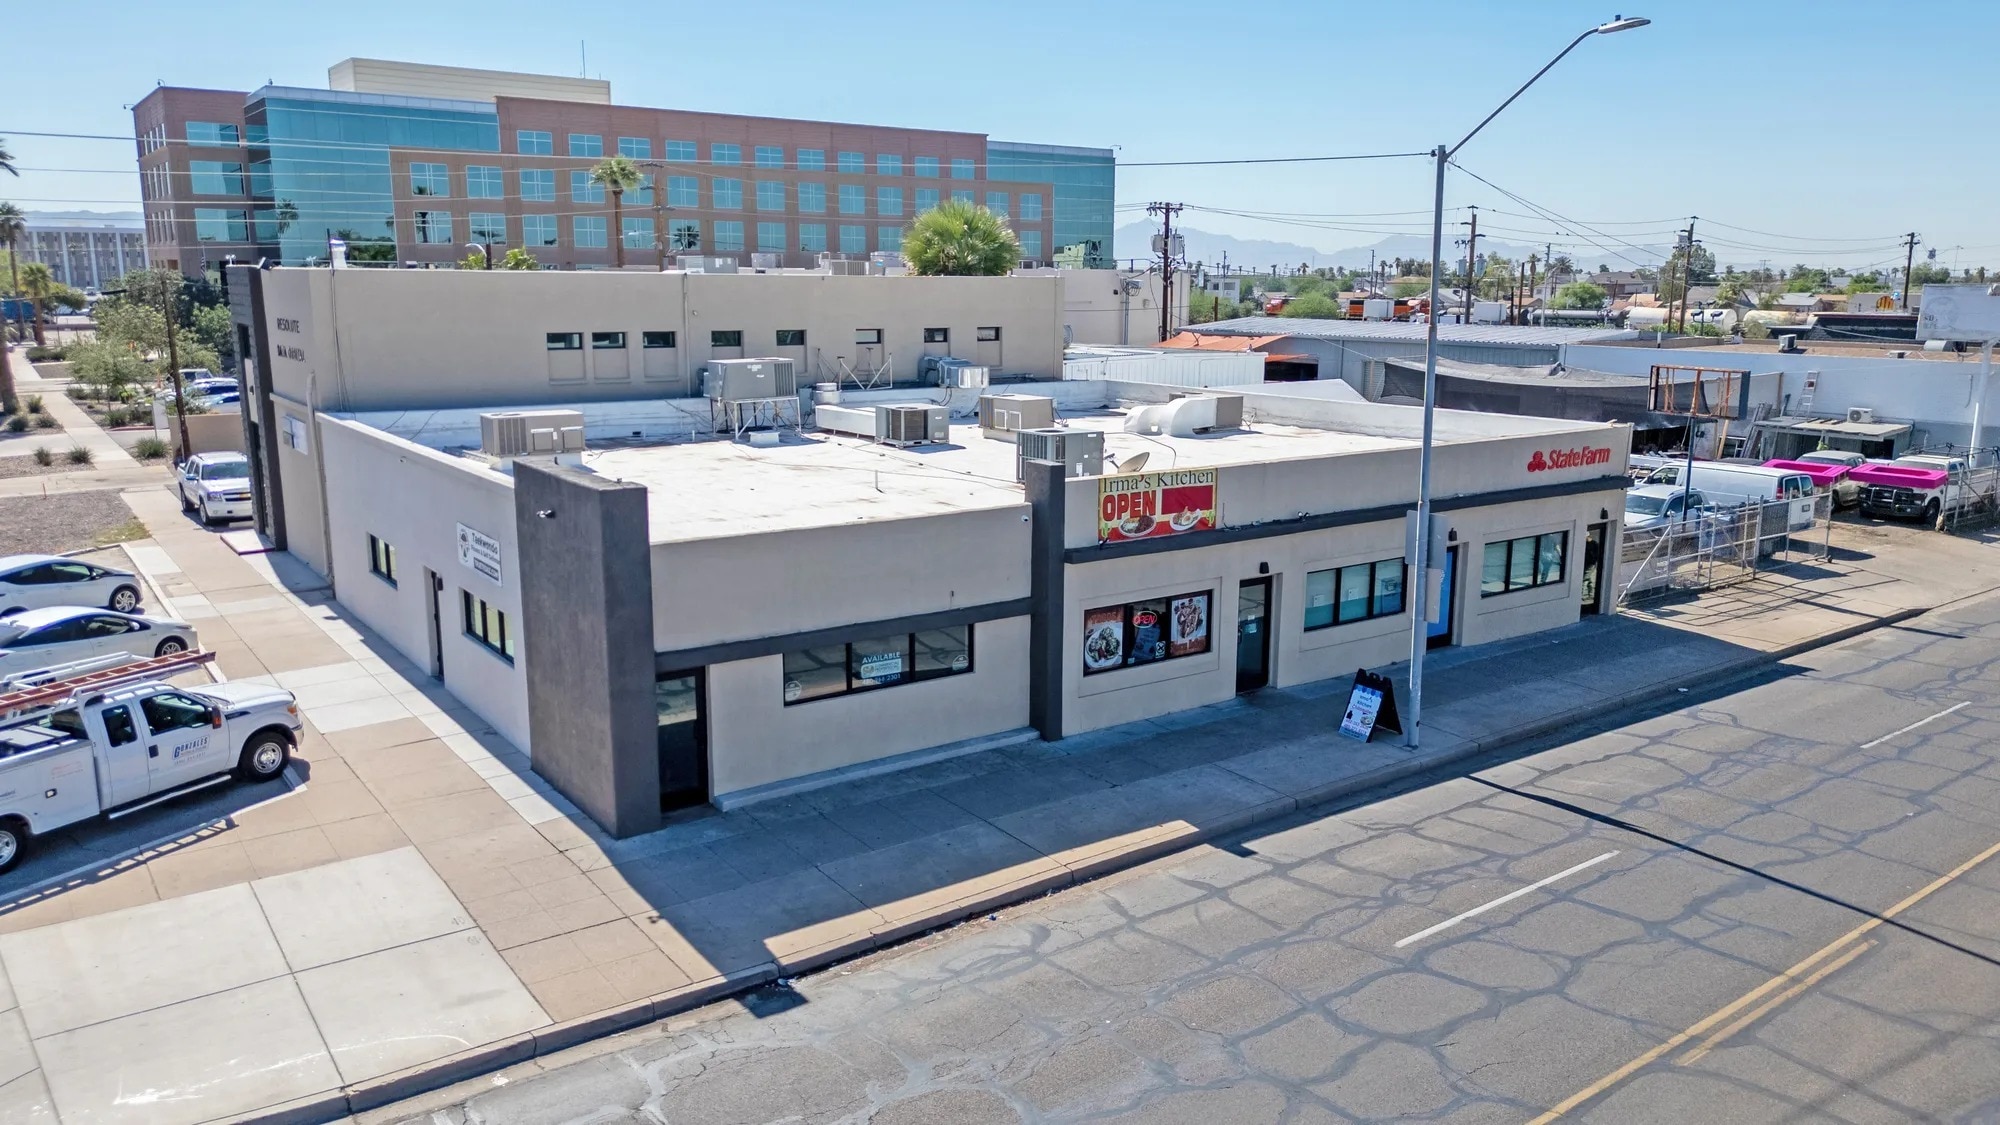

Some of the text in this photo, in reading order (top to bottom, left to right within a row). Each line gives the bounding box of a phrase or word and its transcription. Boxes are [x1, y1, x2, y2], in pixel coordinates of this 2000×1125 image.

[1102, 470, 1214, 493] Irma's Kitchen
[1102, 490, 1156, 521] OPEN
[1134, 615, 1156, 625] OPEN
[862, 651, 900, 664] AVAILABLE
[174, 736, 208, 758] GONZALES
